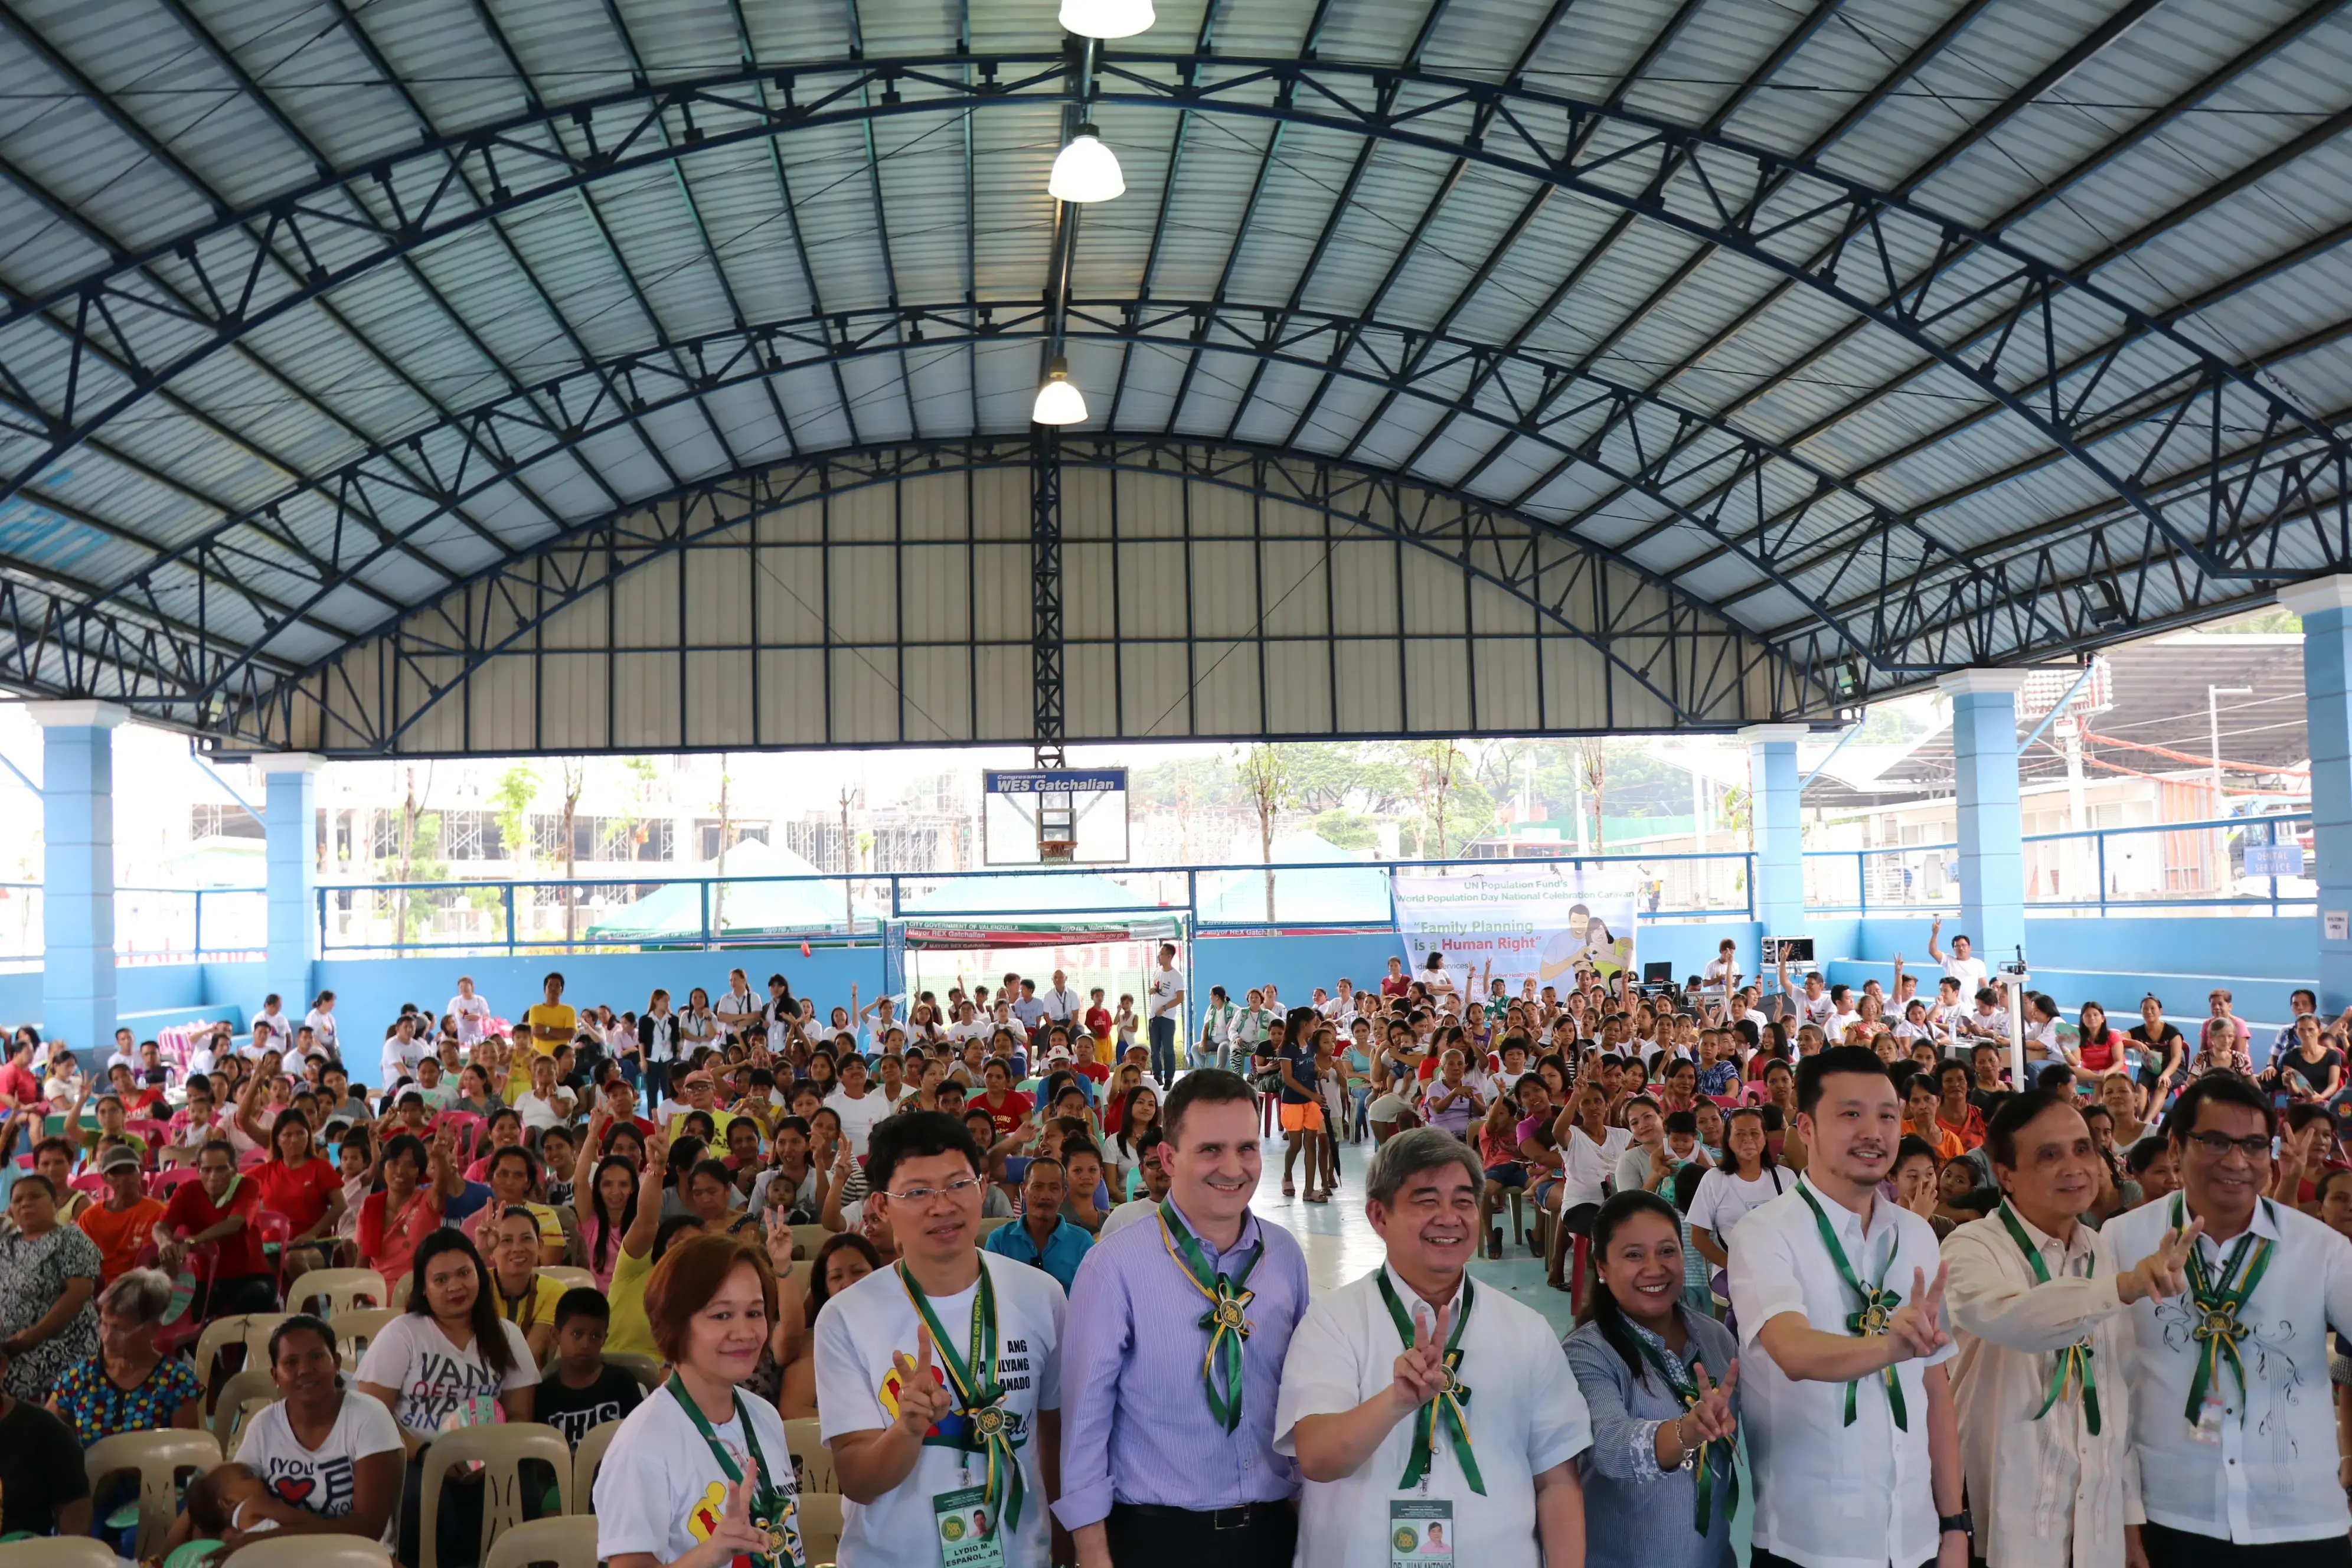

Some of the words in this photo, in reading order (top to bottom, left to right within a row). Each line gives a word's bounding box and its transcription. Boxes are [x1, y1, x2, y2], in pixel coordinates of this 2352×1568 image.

[997, 779, 1030, 792] WES
[1034, 778, 1115, 791] Gatchalian
[2257, 852, 2288, 861] DENTAL
[2255, 863, 2291, 872] SERVICE
[1464, 881, 1479, 890] UN
[1482, 880, 1534, 891] Population
[1396, 894, 1425, 903] World
[1427, 893, 1478, 903] Population
[1481, 893, 1498, 902] Day
[1501, 892, 1540, 901] National
[1542, 891, 1595, 900] Celebration
[1597, 890, 1635, 899] Caravan
[908, 929, 930, 937] Mayor
[1472, 919, 1534, 935] Planning
[1414, 939, 1425, 951] is
[1430, 942, 1438, 951] a
[1442, 938, 1493, 951] Human
[997, 1115, 1011, 1123] GUNS
[974, 1323, 981, 1335] ON
[1007, 1339, 1028, 1354] ANG
[277, 1458, 314, 1475] YOU
[954, 1545, 978, 1556] LYDIO
[945, 1554, 986, 1567] ESPAÑOL,
